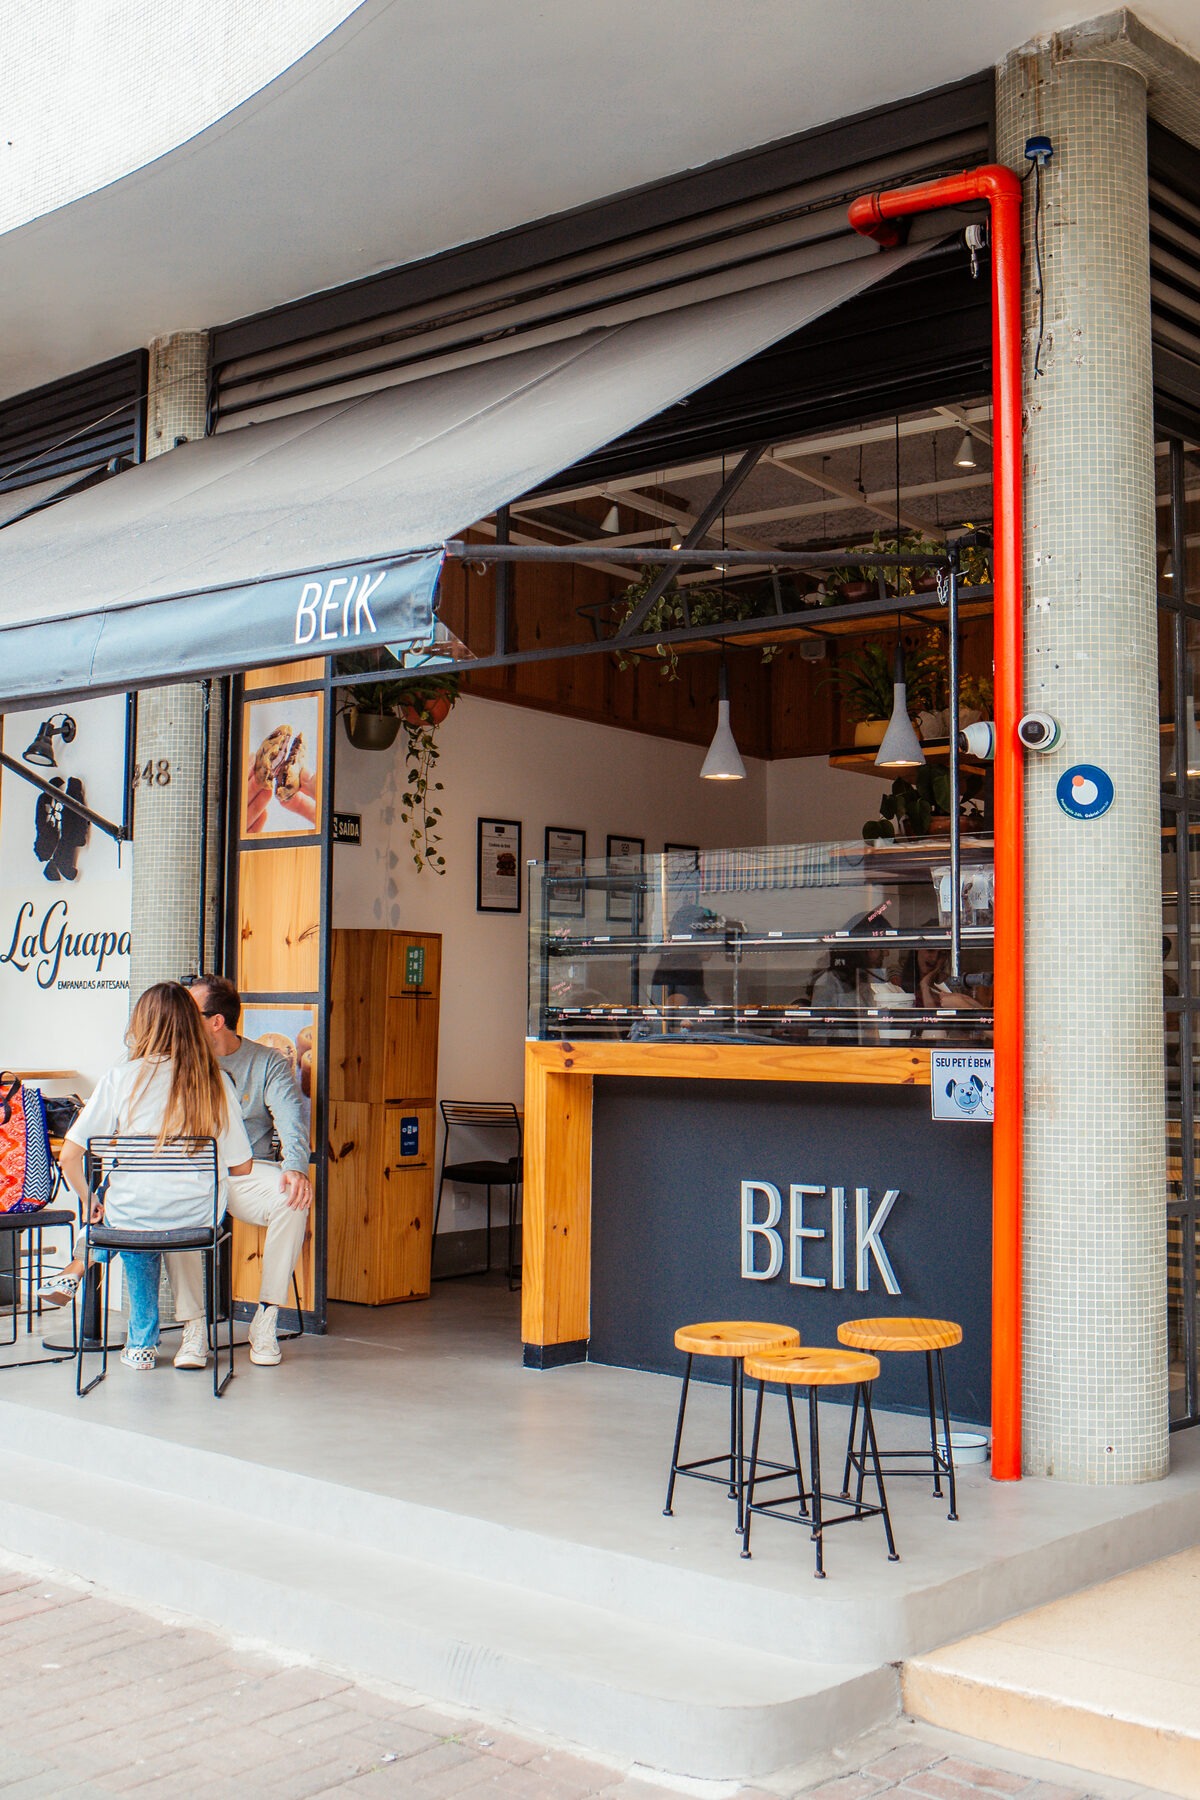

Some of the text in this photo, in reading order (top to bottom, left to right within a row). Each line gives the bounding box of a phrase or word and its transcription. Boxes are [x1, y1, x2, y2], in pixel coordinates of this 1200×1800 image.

[295, 571, 386, 644] BEIK
[339, 819, 360, 837] SAÍDA
[57, 980, 96, 990] EMPANADAS
[936, 1055, 991, 1068] SEU PET É BEM
[741, 1179, 901, 1295] BEIK
